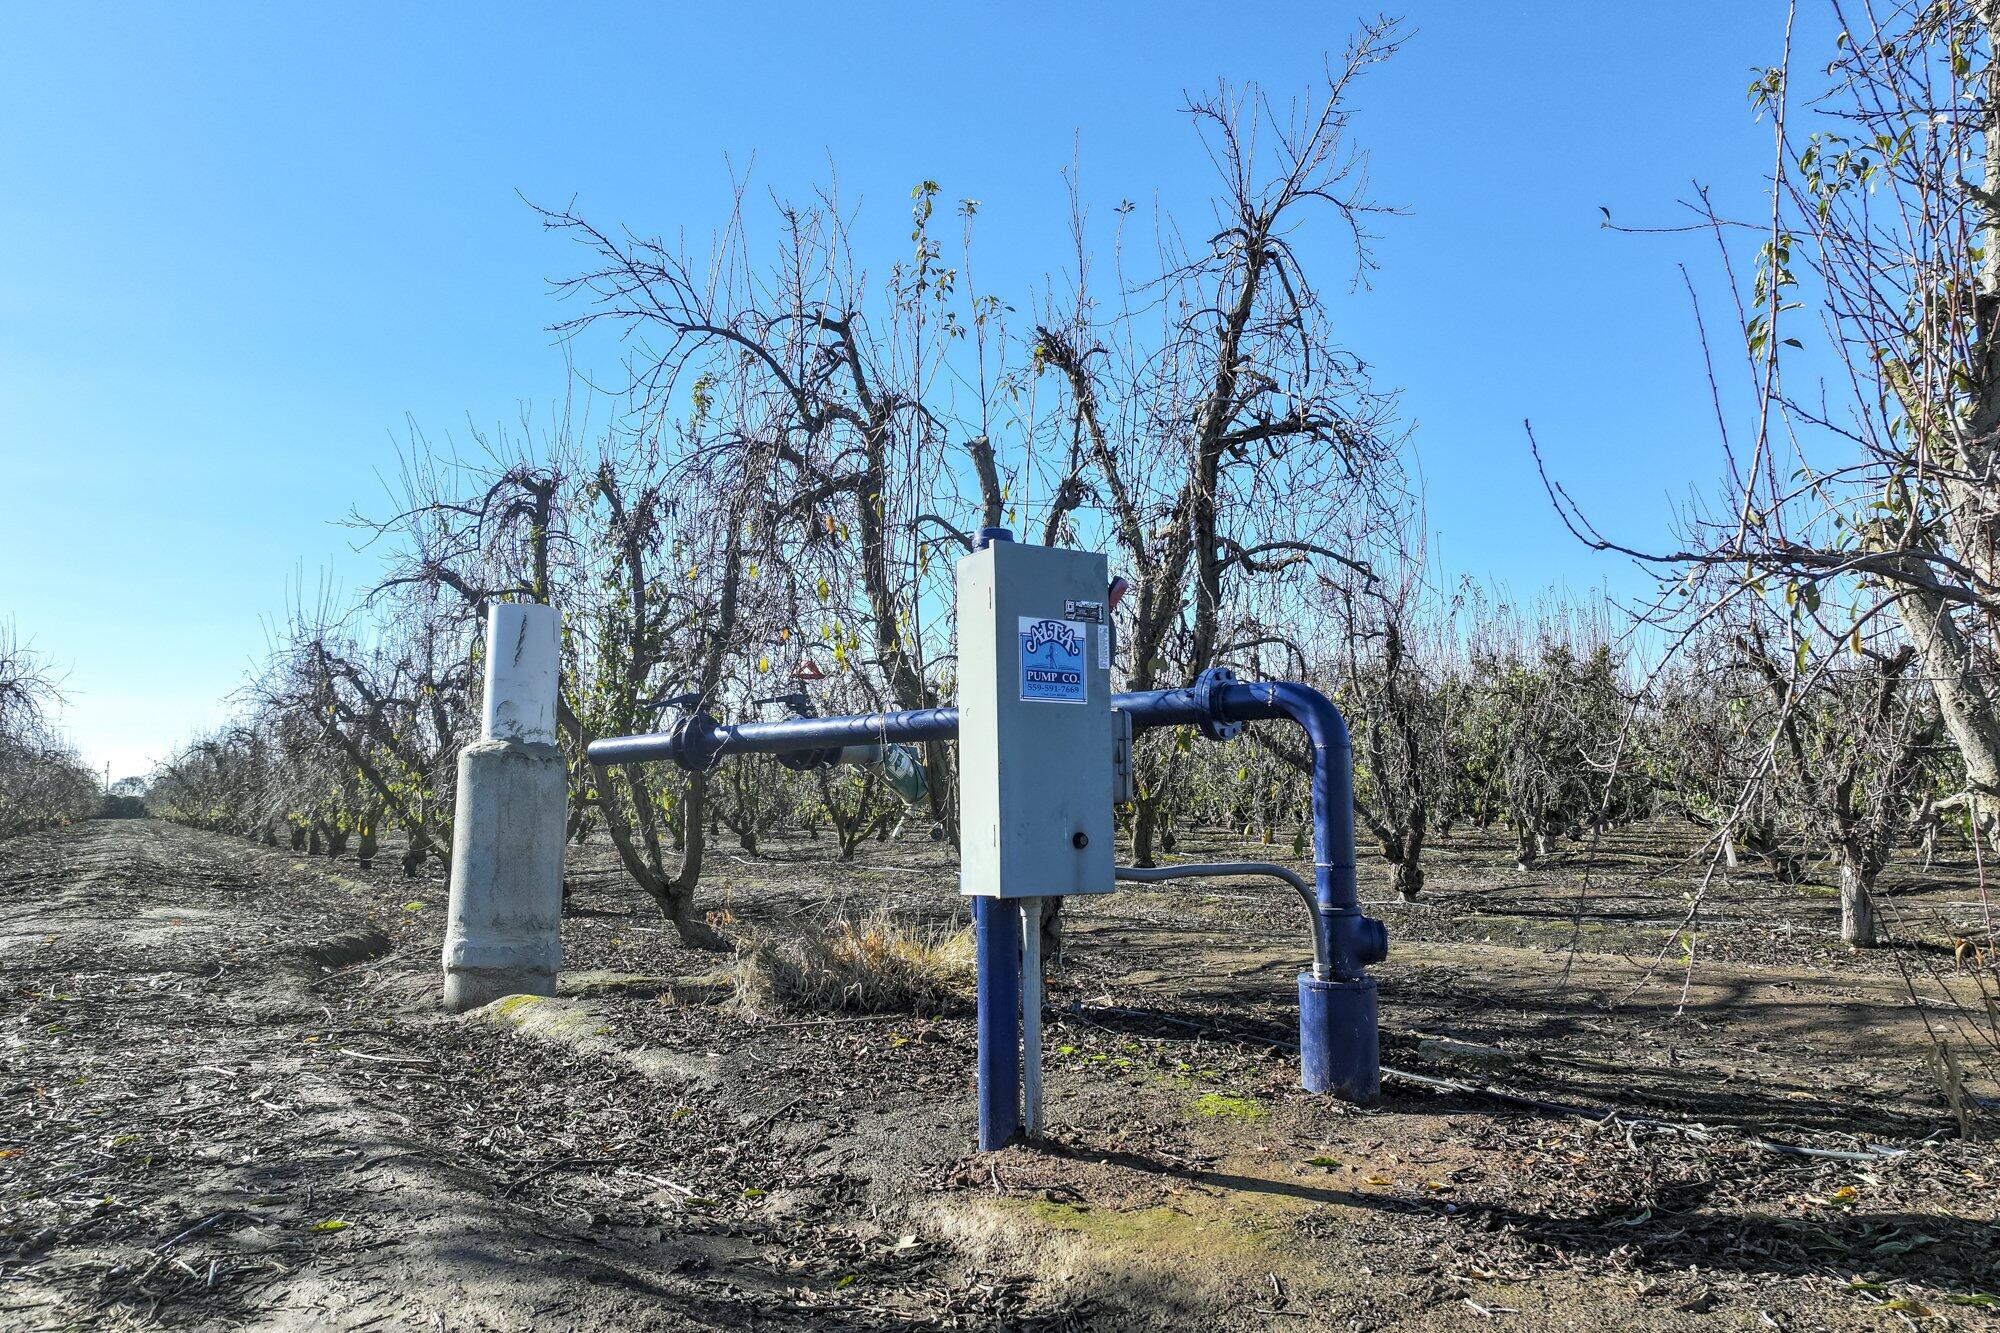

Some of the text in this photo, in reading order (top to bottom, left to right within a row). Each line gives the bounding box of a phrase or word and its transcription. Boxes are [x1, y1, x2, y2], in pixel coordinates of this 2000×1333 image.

[1026, 620, 1080, 656] ALTA
[1027, 672, 1080, 684] PUMP CO.
[1027, 683, 1079, 693] 559-591-7669
